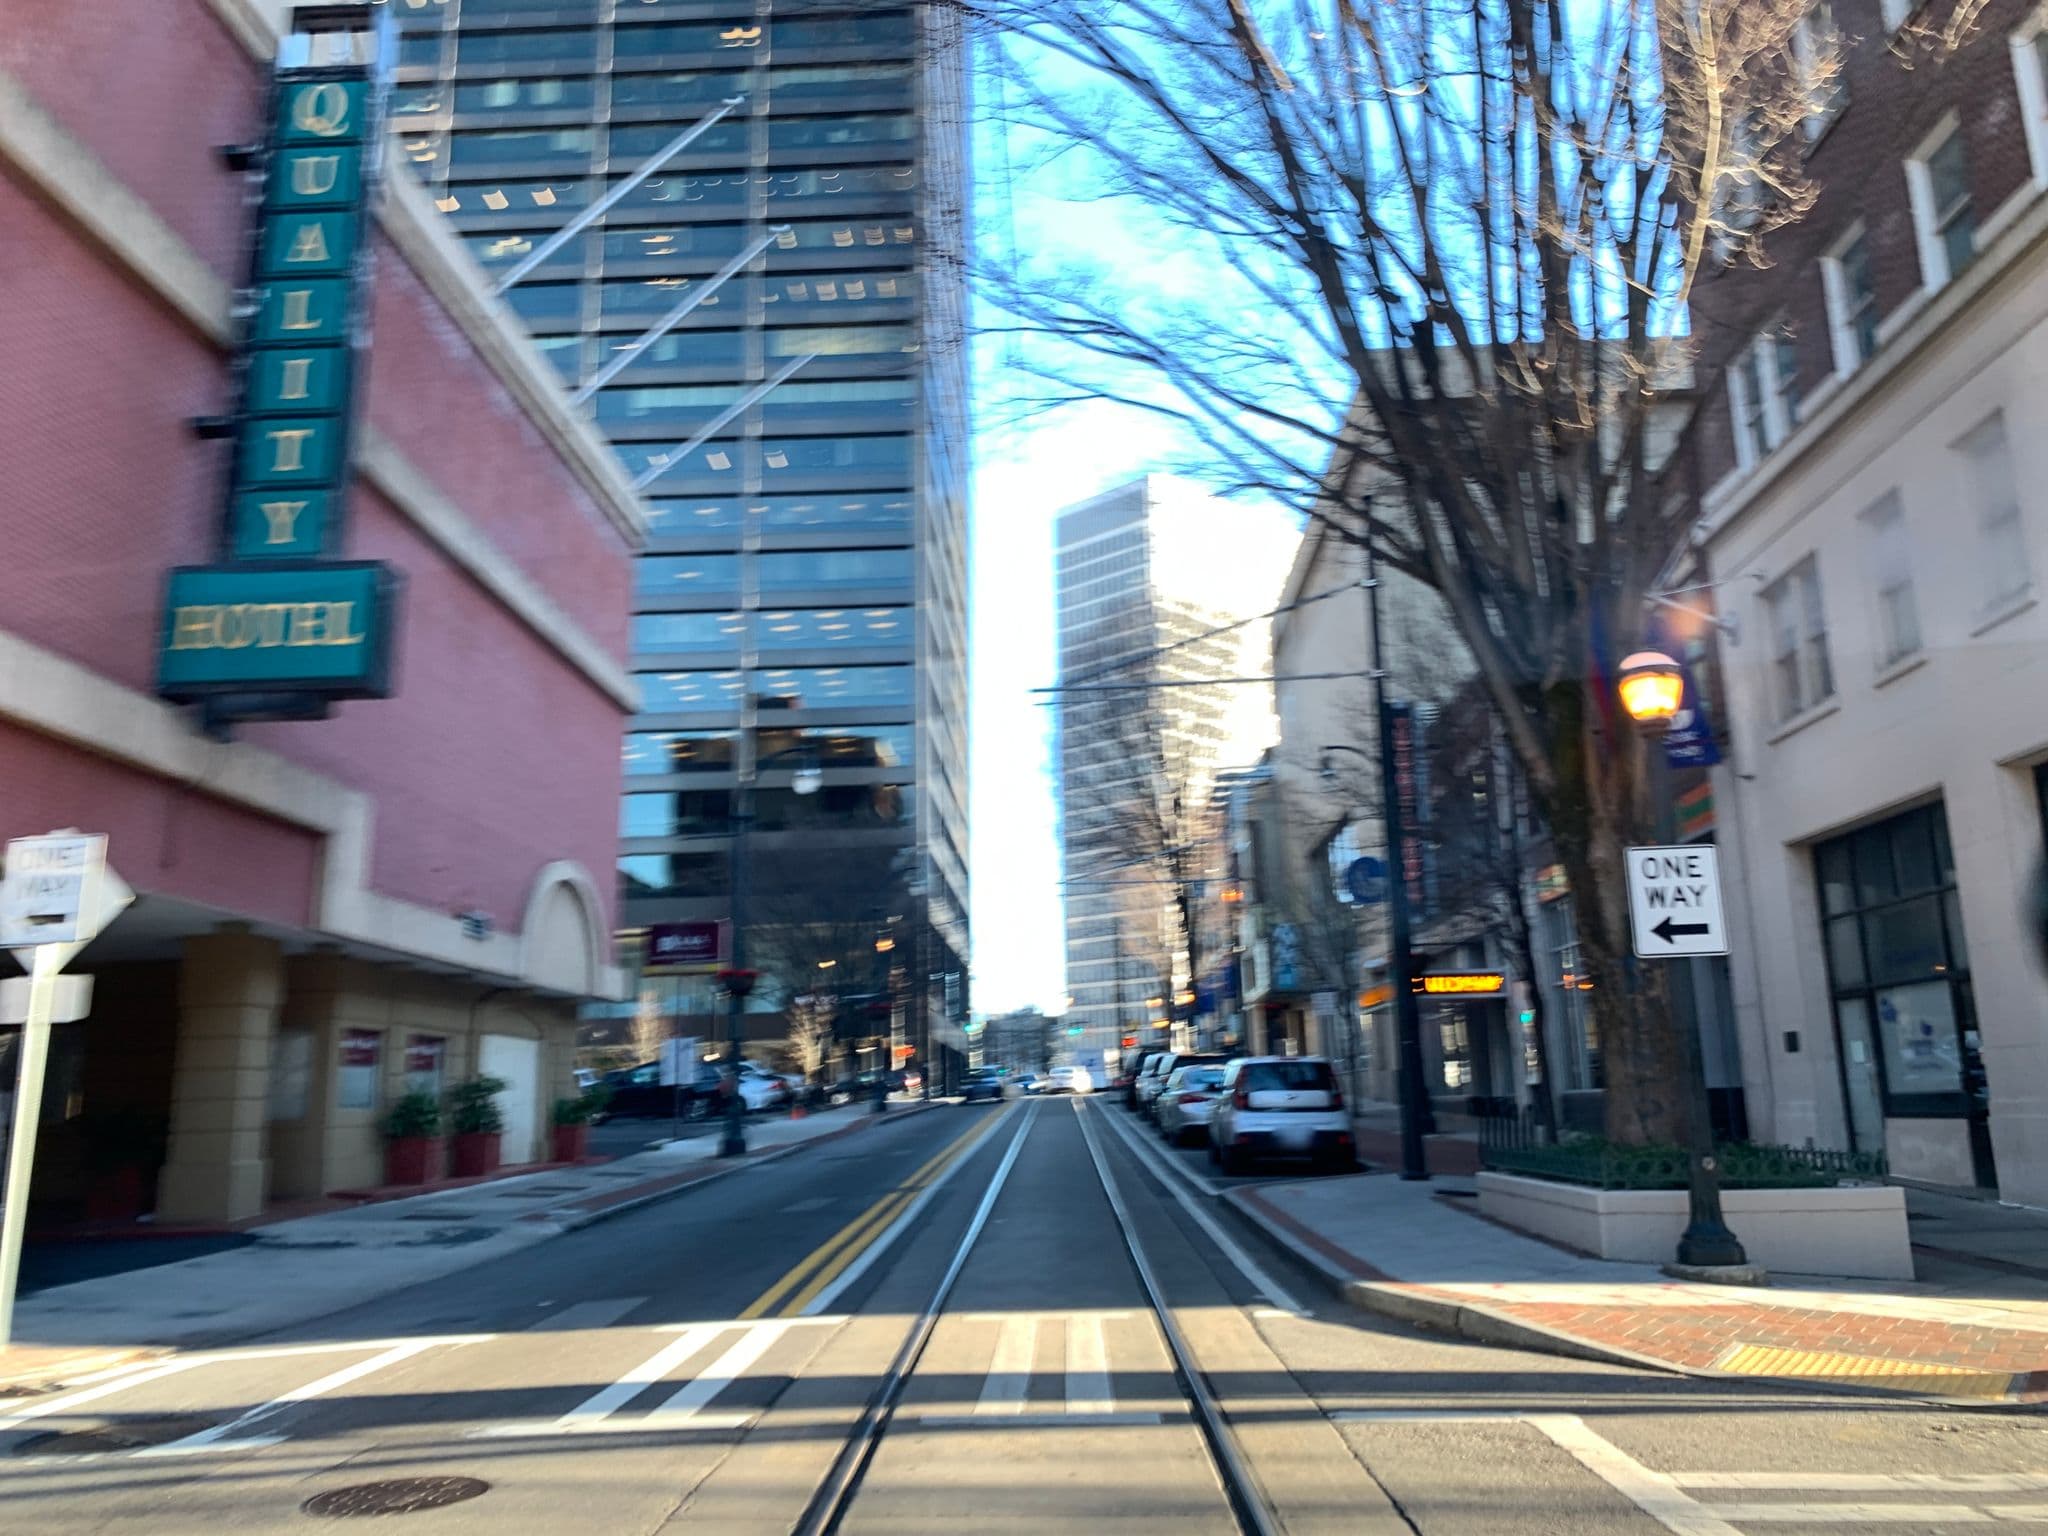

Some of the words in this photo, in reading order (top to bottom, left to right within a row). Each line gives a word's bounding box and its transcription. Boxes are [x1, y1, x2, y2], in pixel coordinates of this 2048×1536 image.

[262, 83, 350, 545] QUALITY
[169, 601, 366, 650] HOTEL
[1641, 855, 1703, 879] ONE
[1644, 884, 1708, 909] WAY
